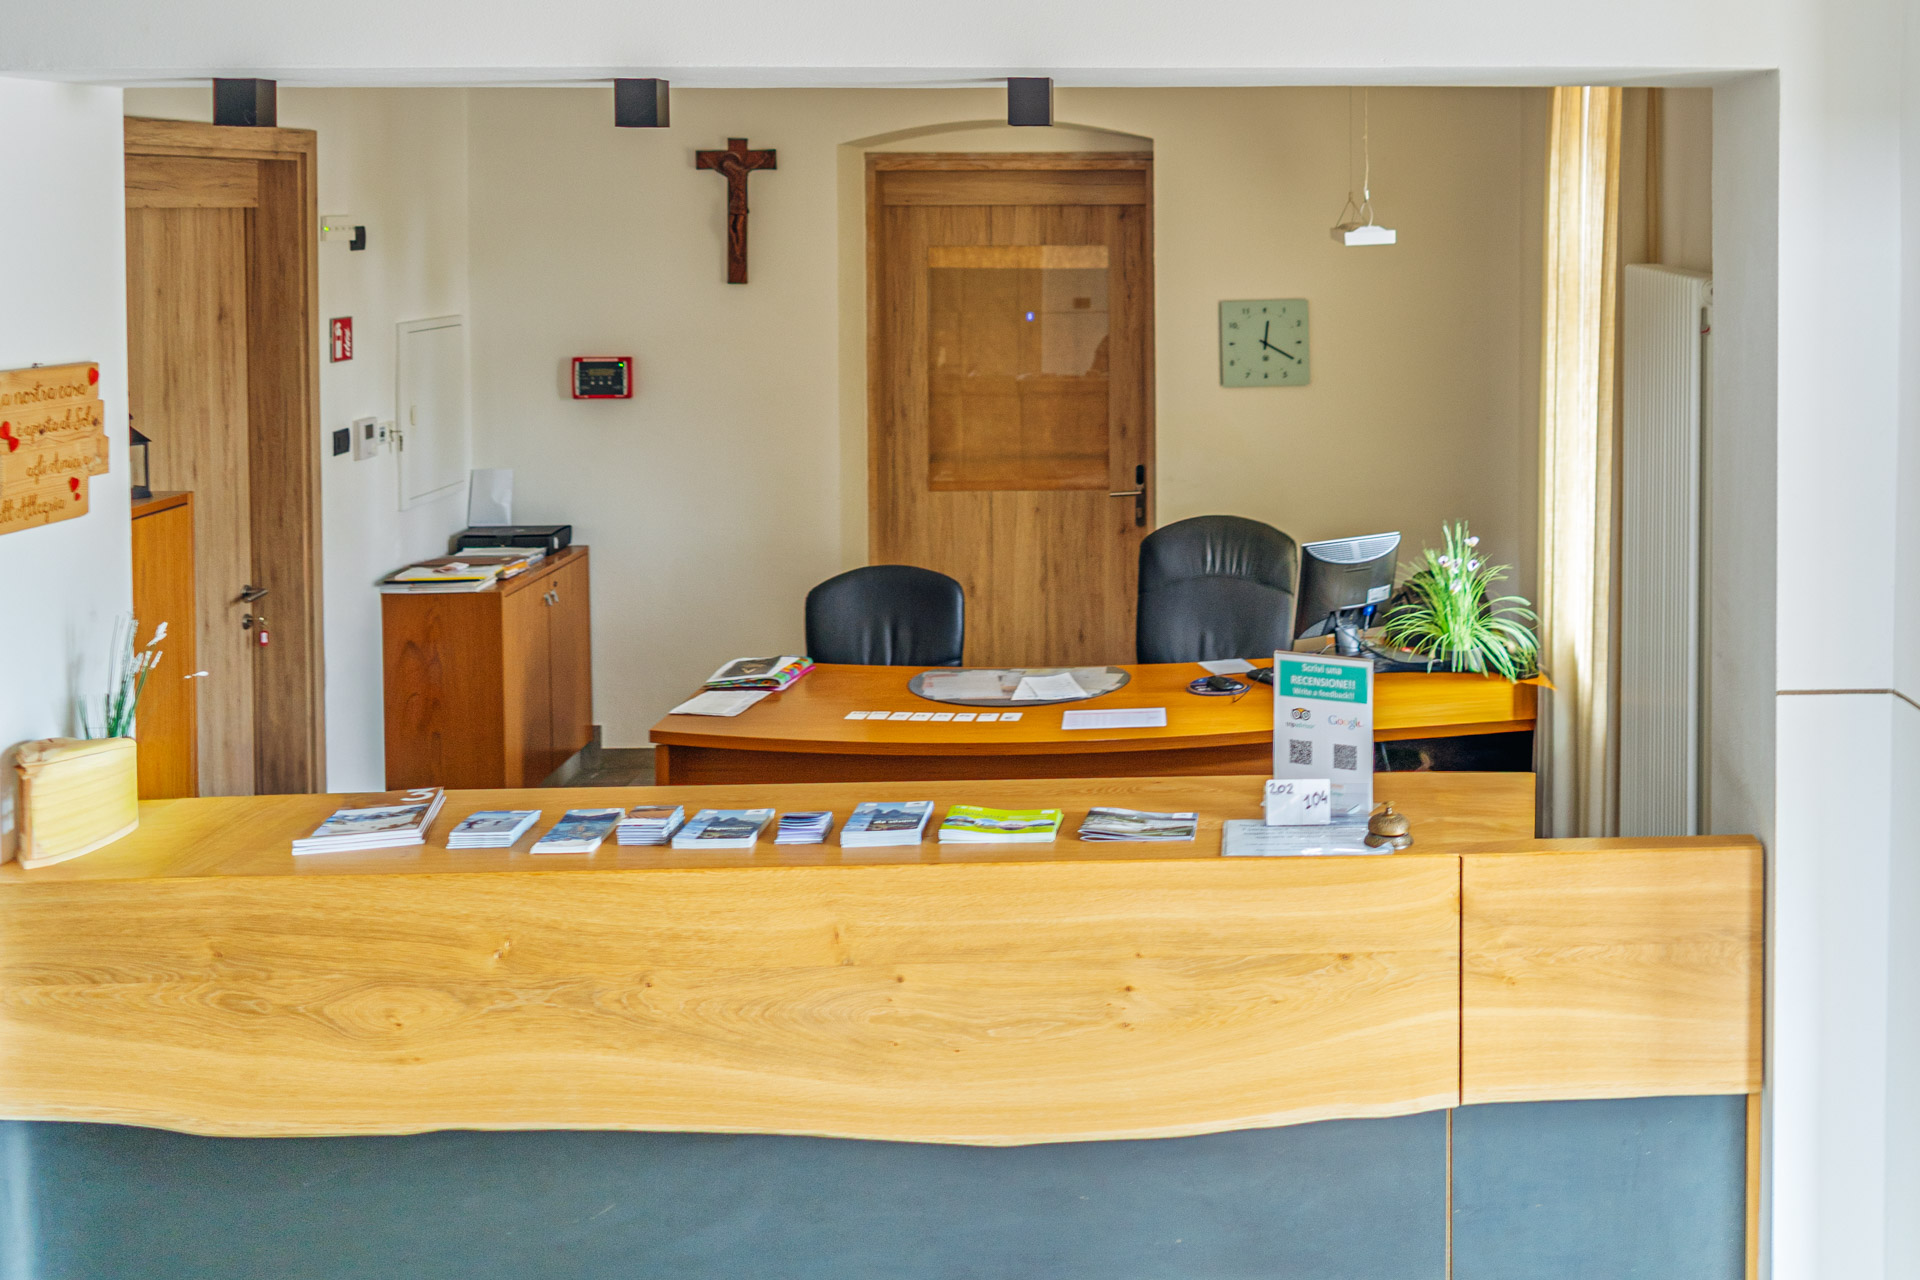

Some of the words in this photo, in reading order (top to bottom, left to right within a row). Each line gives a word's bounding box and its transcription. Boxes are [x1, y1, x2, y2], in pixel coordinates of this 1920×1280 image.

[1301, 663, 1325, 674] Scrivi
[1326, 667, 1342, 675] una
[1290, 675, 1356, 690] RECENSIONE!!
[1292, 687, 1312, 696] Write
[1328, 715, 1363, 730] Google
[1269, 783, 1294, 794] 202
[1303, 790, 1328, 810] 104
